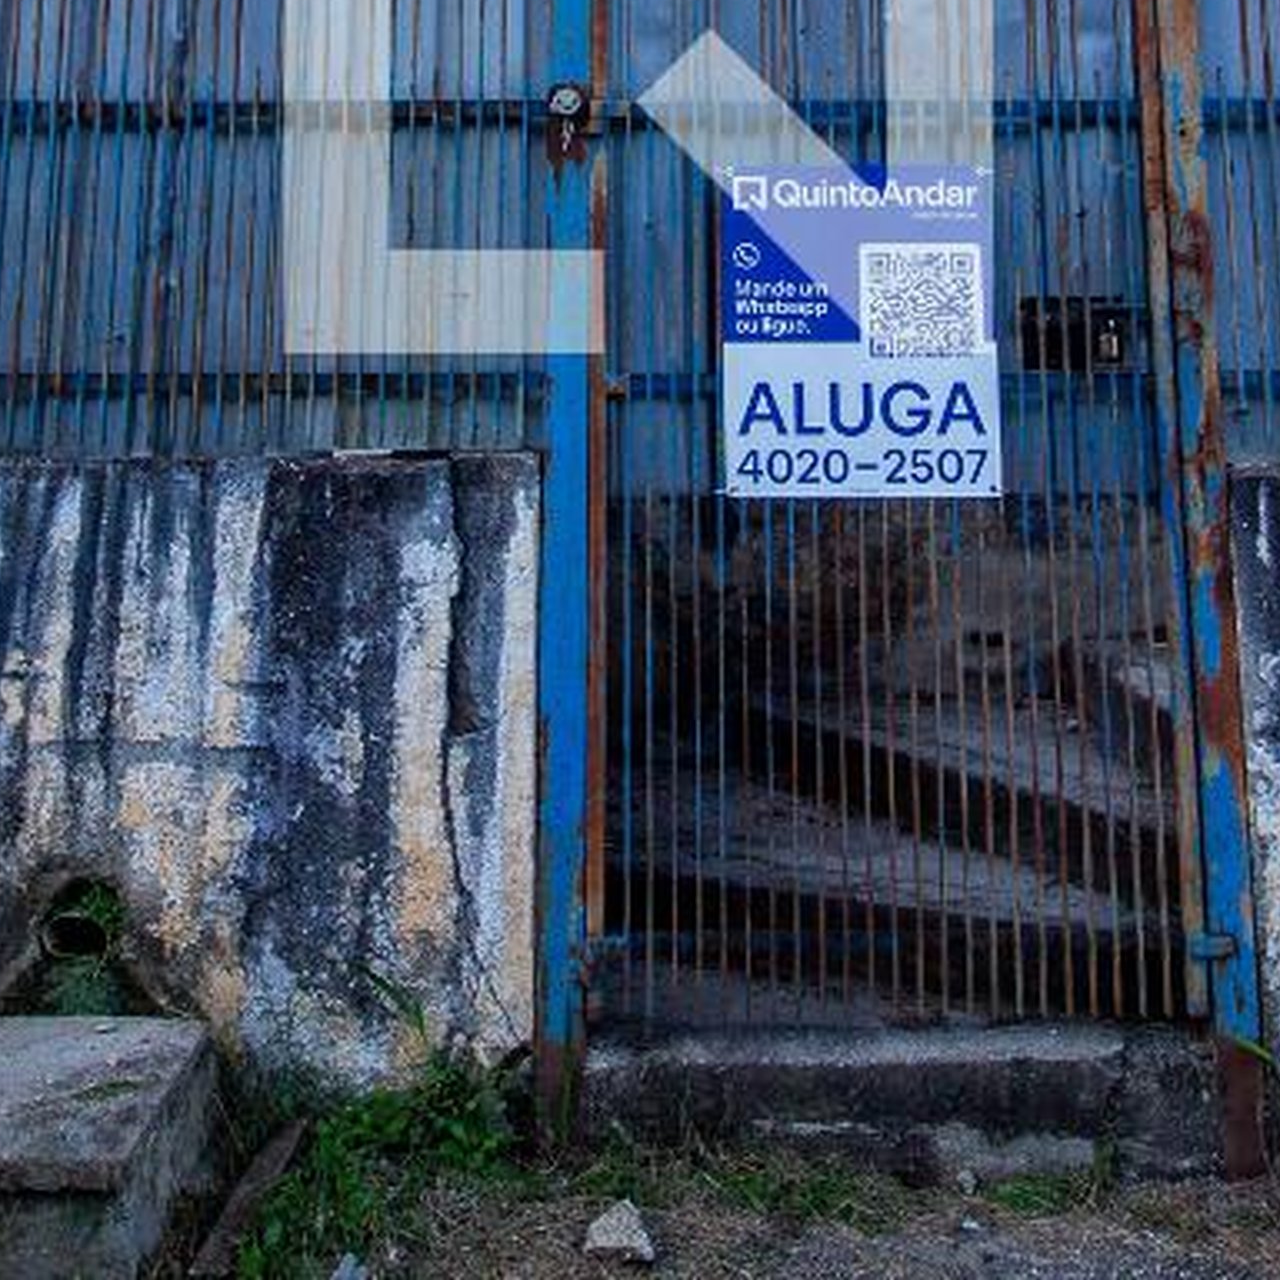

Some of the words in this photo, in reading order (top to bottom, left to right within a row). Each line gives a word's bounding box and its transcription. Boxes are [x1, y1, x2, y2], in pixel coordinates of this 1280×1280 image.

[773, 179, 978, 208] QuintoAndar
[738, 381, 987, 437] ALUGA
[737, 449, 988, 484] 4020-2507
